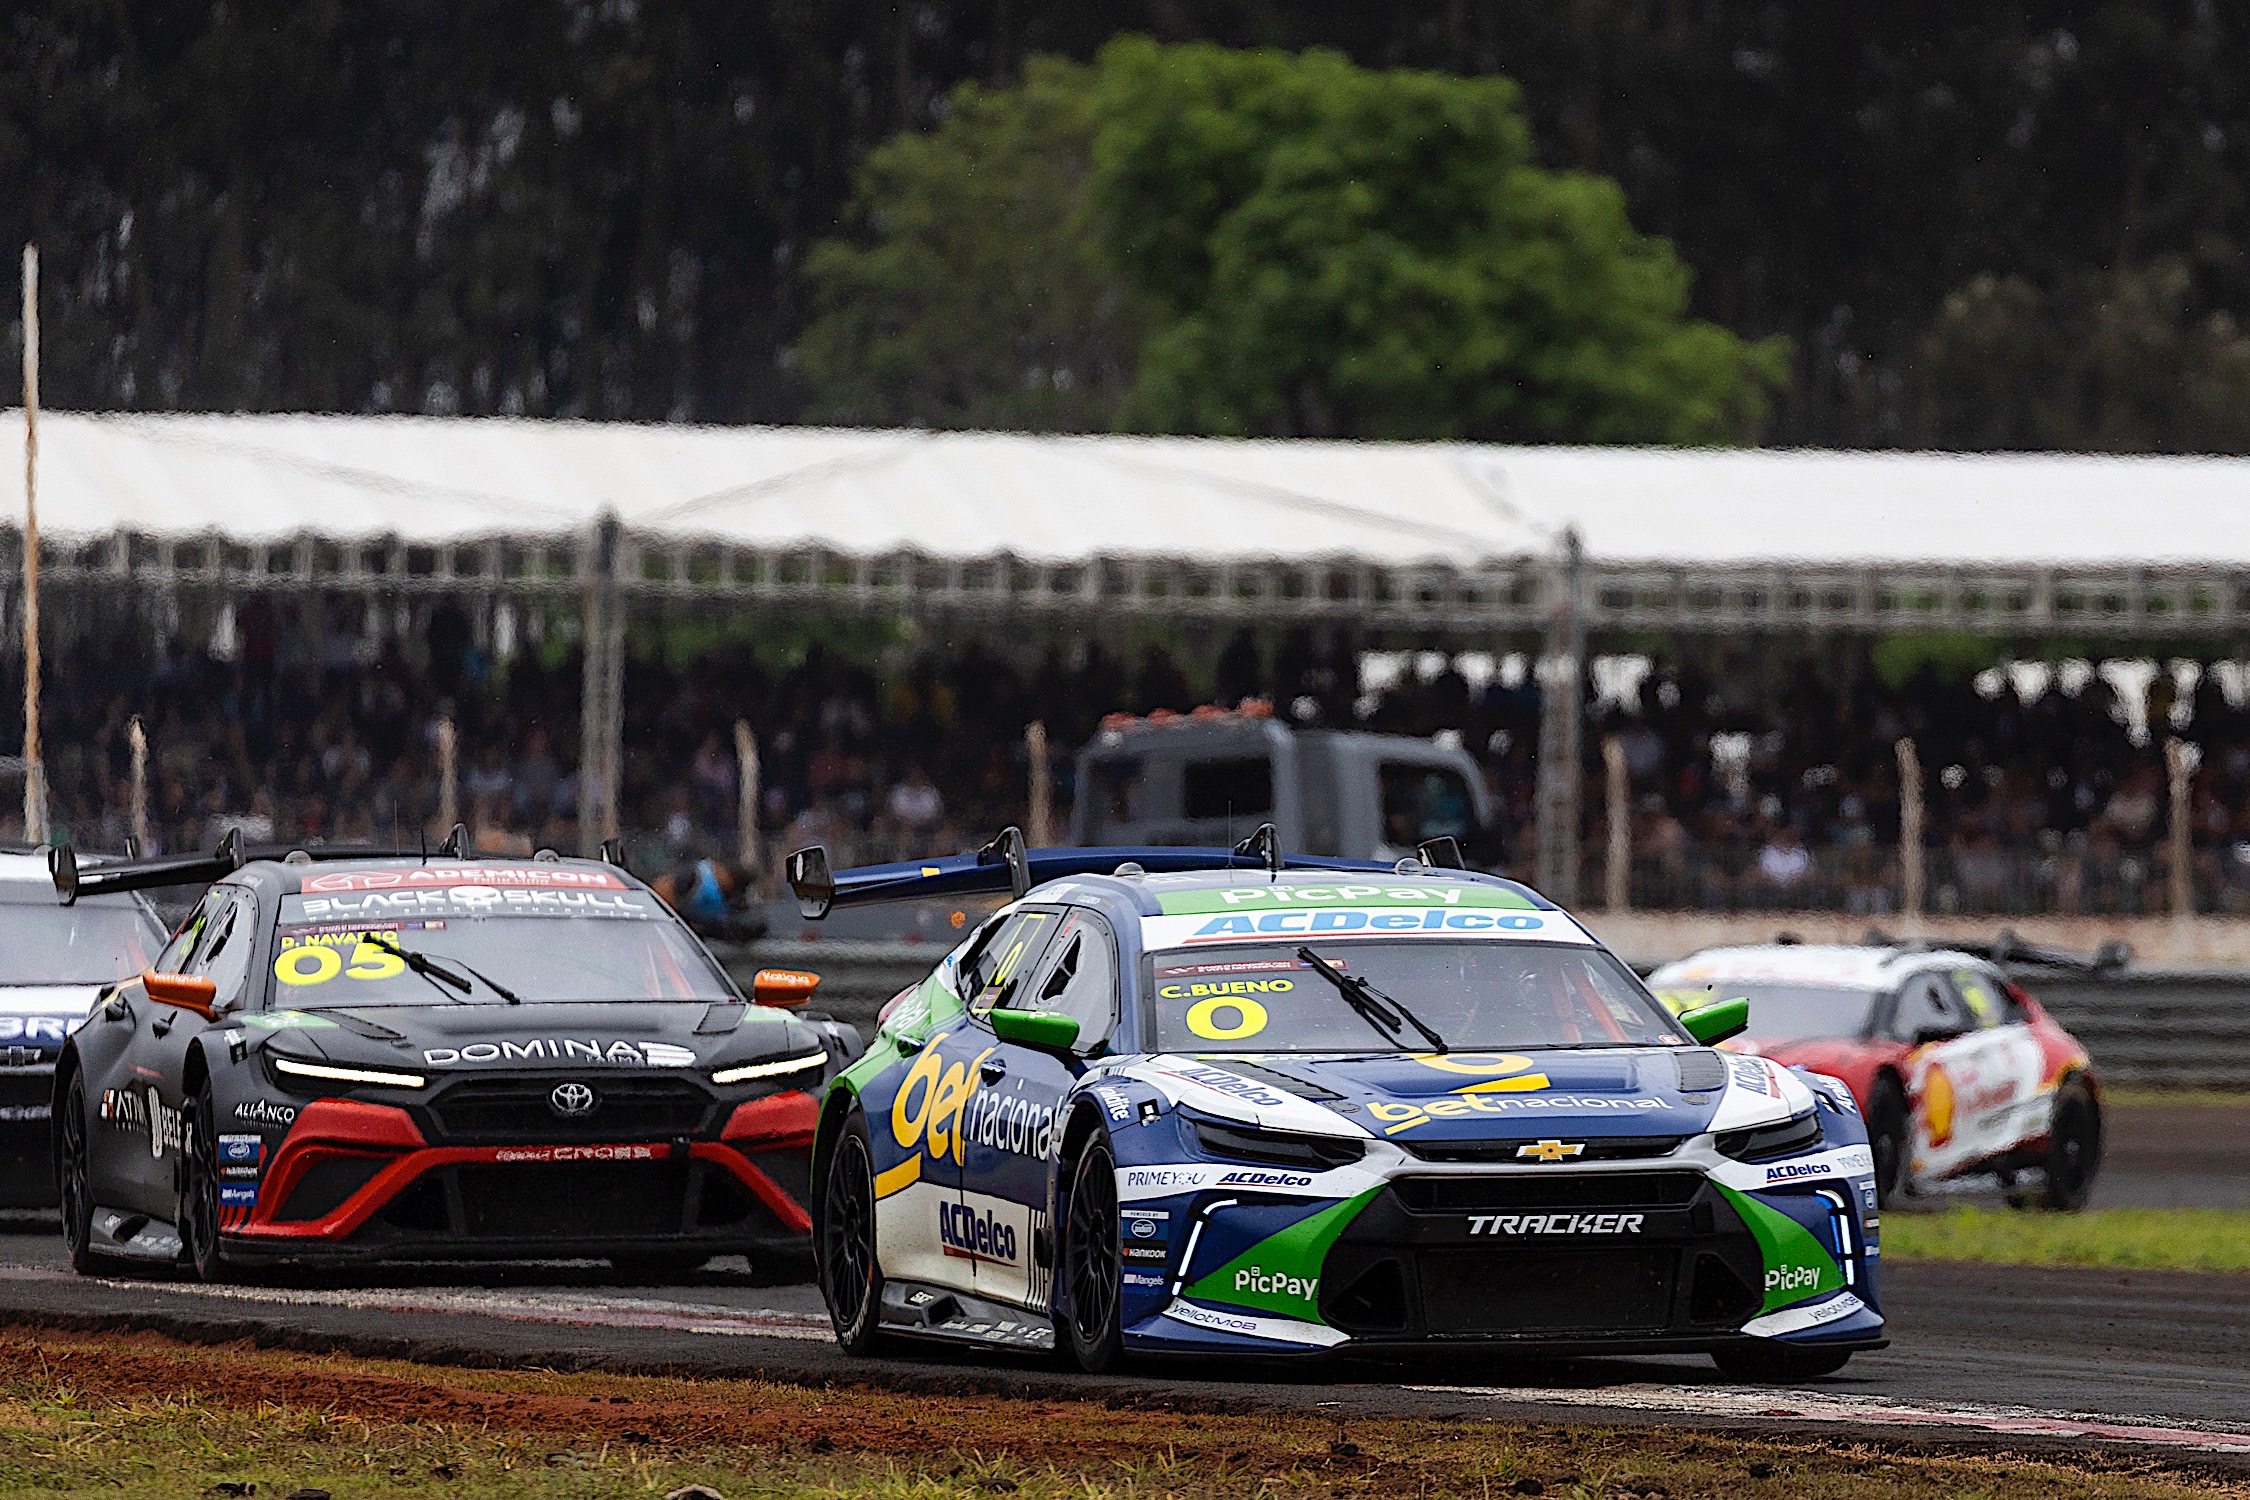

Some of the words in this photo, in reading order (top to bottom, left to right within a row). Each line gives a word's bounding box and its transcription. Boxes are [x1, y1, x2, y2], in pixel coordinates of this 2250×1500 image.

[409, 869, 608, 885] ADEMICON
[303, 889, 446, 914] BLACK
[503, 889, 643, 910] SKULL
[1220, 884, 1461, 904] PicPay
[1193, 910, 1544, 935] ACDelco
[281, 937, 300, 949] D.
[275, 940, 406, 986] 05
[1186, 995, 1268, 1040] 0
[1218, 1172, 1312, 1187] ACDelco
[1766, 1164, 1831, 1180] ACDelco
[939, 1201, 1016, 1261] ACDelco
[1467, 1214, 1644, 1235] TRACKER
[1235, 1267, 1318, 1301] PicPay
[1764, 1264, 1821, 1291] PicPay
